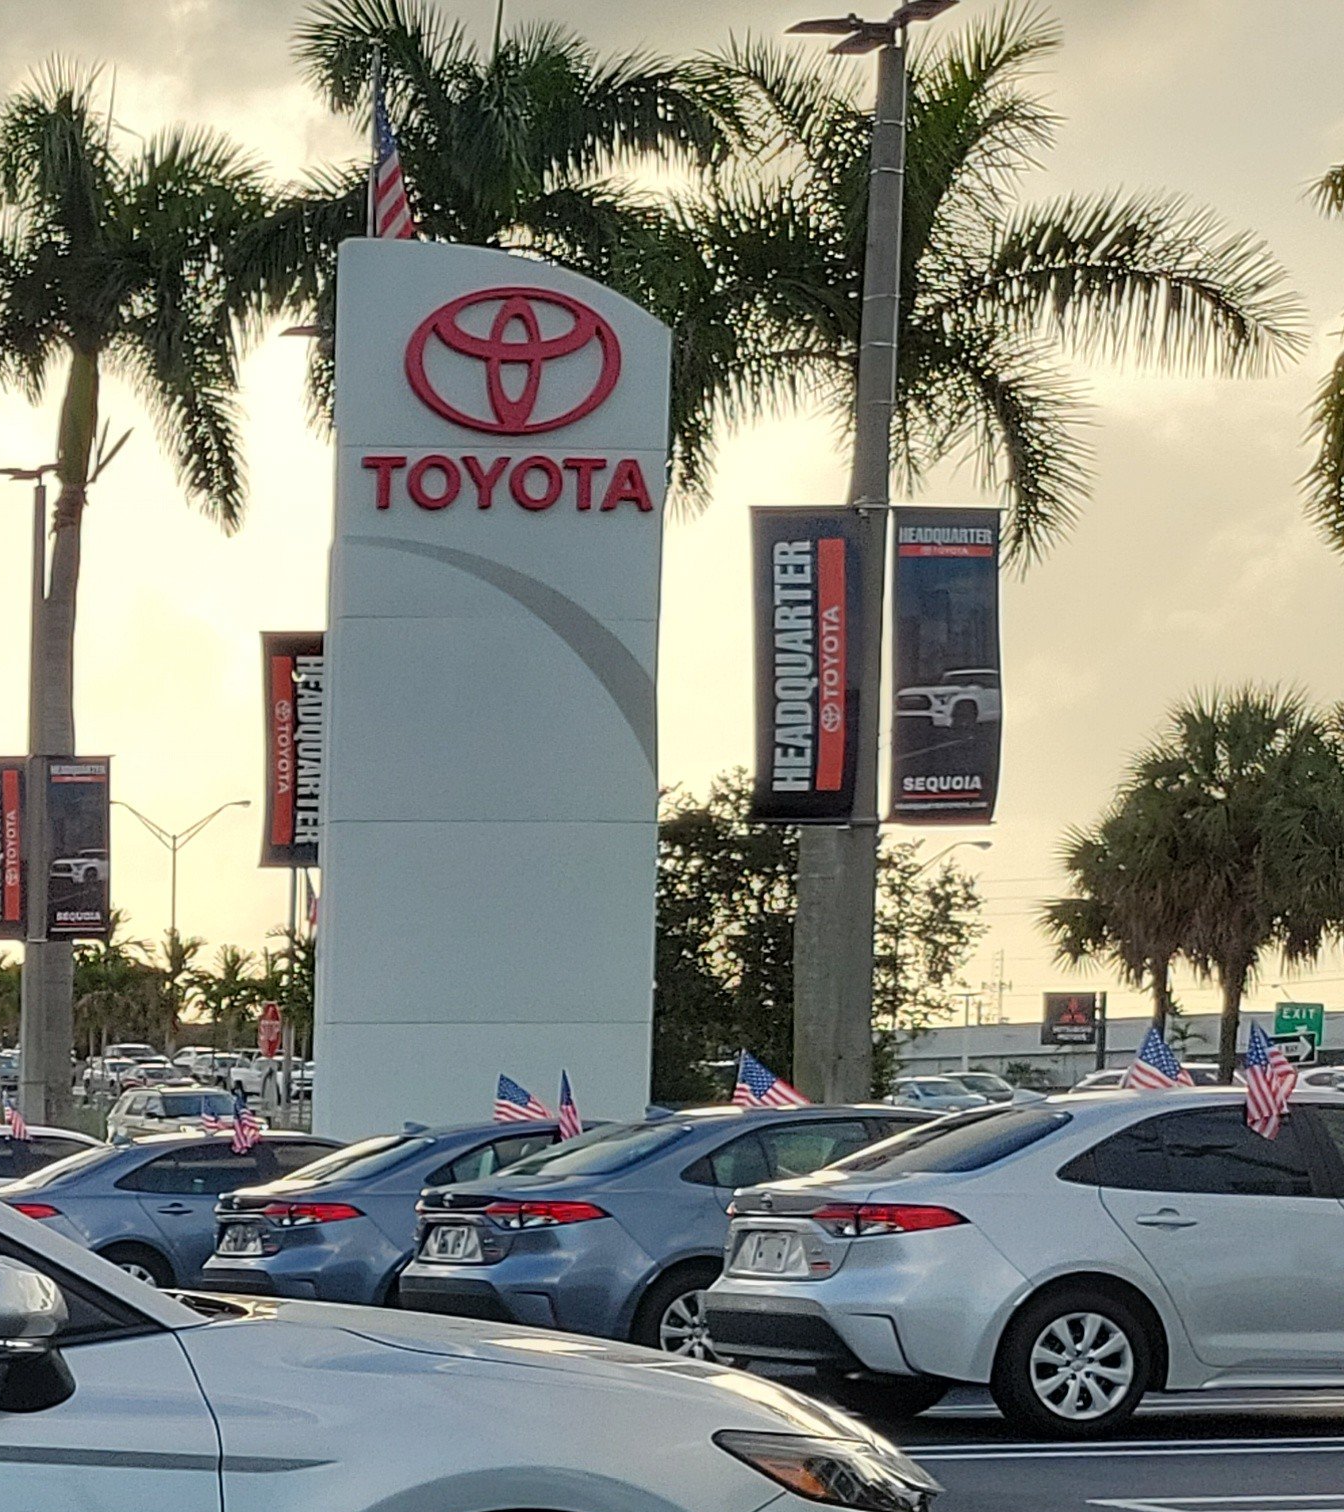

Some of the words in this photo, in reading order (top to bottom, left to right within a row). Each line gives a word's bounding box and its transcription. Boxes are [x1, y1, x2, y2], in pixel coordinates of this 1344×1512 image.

[362, 455, 653, 512] TOYOTA
[899, 527, 992, 545] HEADQUARTER
[772, 540, 819, 792] HEADQUARTER
[822, 605, 841, 700] TOYOTA
[277, 724, 291, 794] TOYOTA
[293, 656, 324, 844] HEADQUARTER
[902, 775, 983, 793] SEQUOIA
[5, 810, 18, 870] TOYOTA
[1282, 1007, 1315, 1020] EXIT
